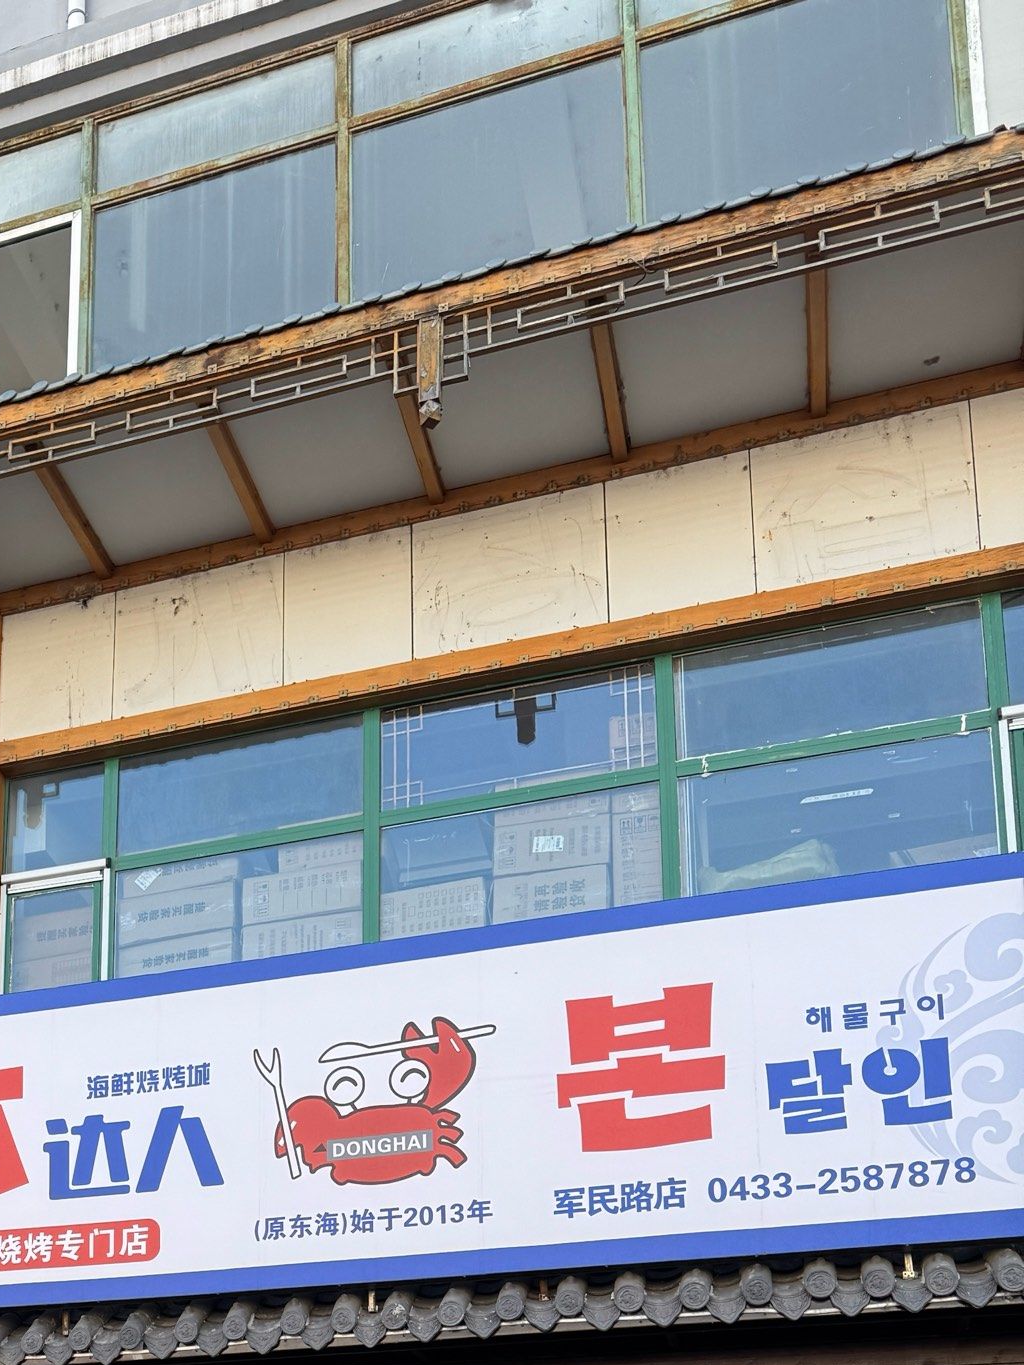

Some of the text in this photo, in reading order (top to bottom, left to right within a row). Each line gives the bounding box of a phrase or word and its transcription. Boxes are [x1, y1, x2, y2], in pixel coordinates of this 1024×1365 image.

[805, 994, 945, 1033] 해물구이
[86, 1062, 211, 1099] 海鲜烧烤城
[331, 1133, 428, 1158] DONGHAI
[553, 1157, 976, 1219] 军民路店 0433-2587878
